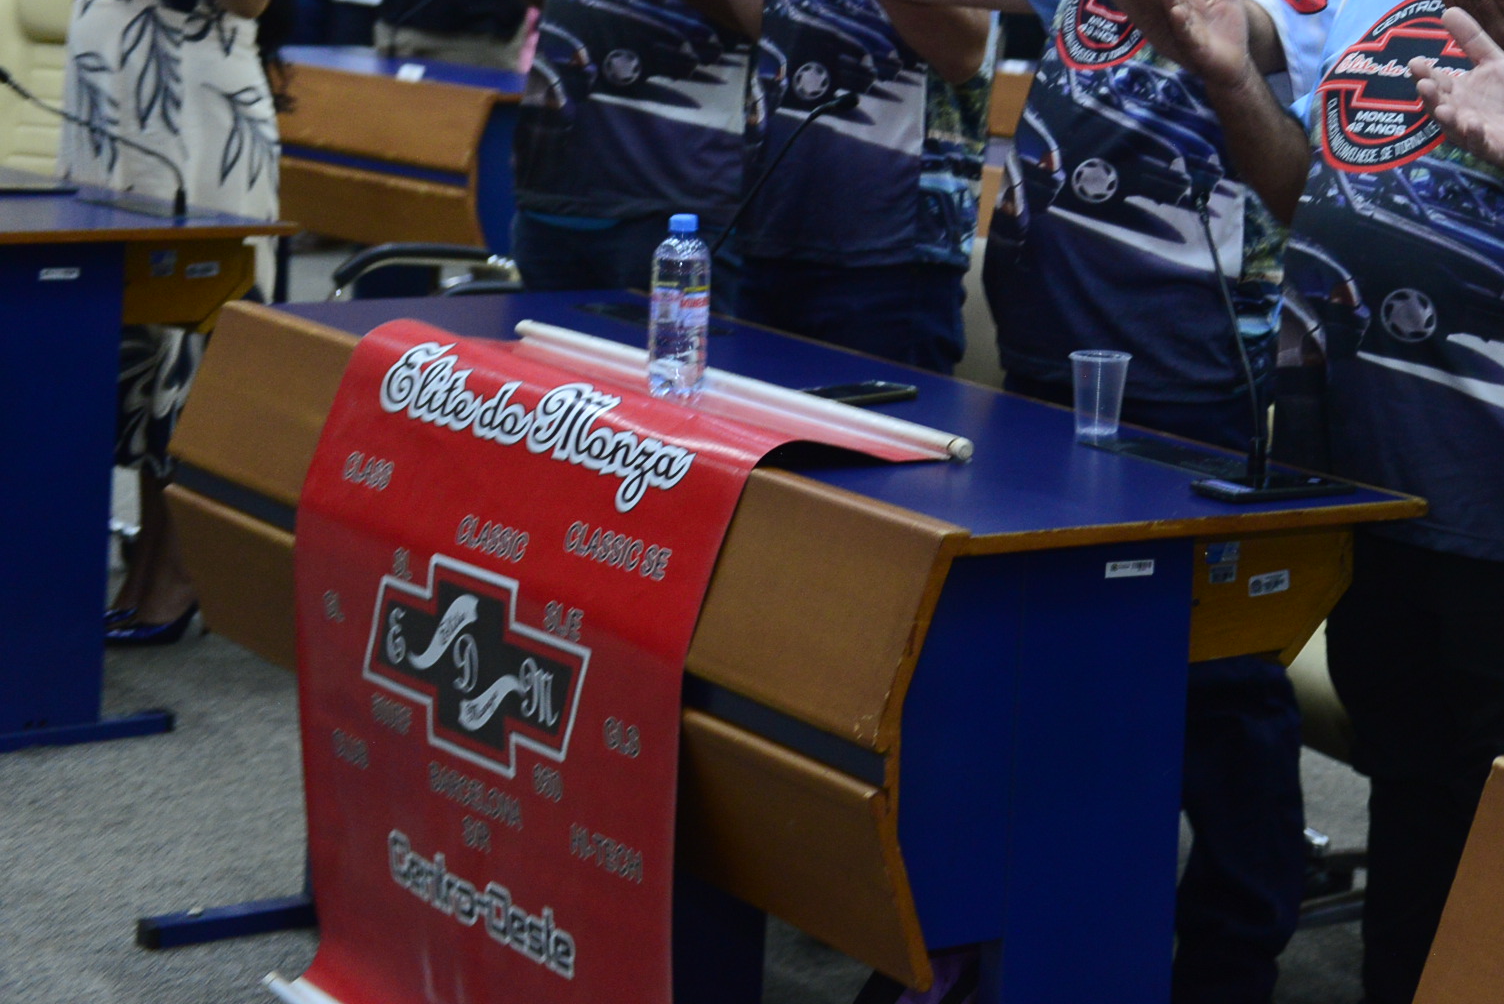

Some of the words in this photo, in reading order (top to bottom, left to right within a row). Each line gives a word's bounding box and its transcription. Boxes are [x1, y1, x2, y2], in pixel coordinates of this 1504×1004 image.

[1372, 0, 1446, 36] CENTRO-
[1355, 111, 1404, 124] MONZA
[1364, 122, 1408, 137] ANOS
[379, 341, 482, 432] Elite
[472, 380, 537, 446] do
[526, 381, 697, 514] Monza
[343, 451, 395, 490] CLASS
[456, 514, 529, 563] CLASSIC
[563, 519, 645, 573] CLASSIC
[639, 542, 673, 582] SE
[604, 715, 641, 759] GLS
[388, 829, 575, 979] Centro-Oeste
